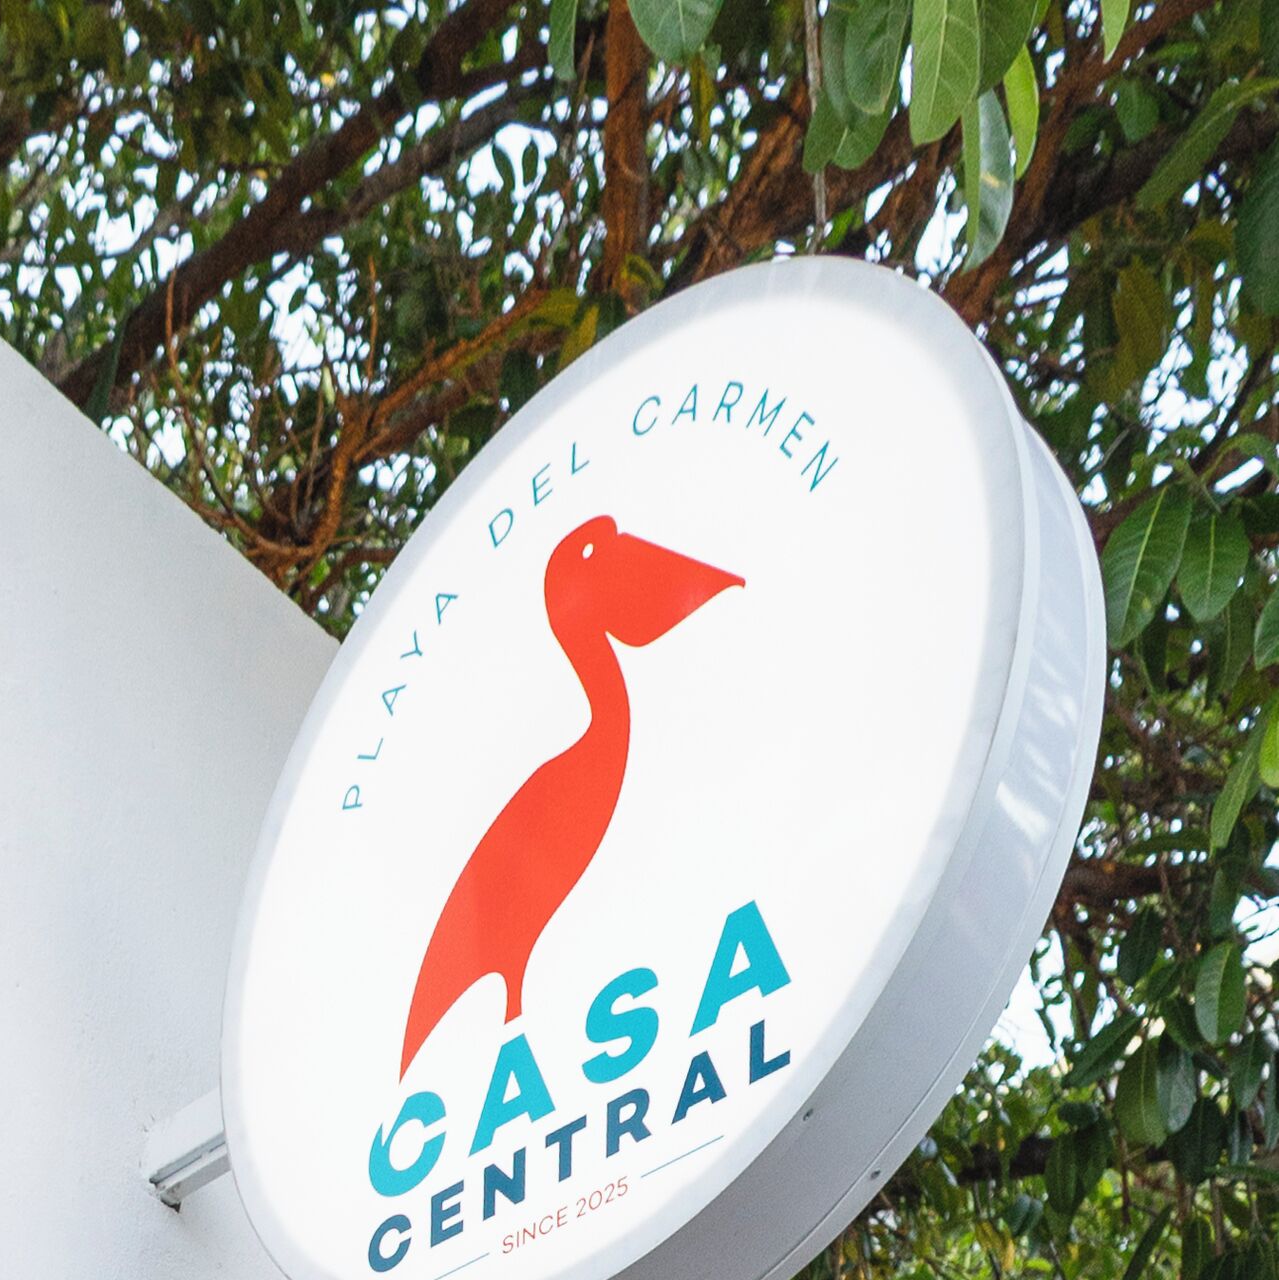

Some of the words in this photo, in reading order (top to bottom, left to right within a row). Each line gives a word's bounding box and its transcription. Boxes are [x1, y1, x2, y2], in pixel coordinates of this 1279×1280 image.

[341, 592, 459, 811] PLAYA
[487, 441, 590, 549] DEL
[632, 380, 839, 493] CARMEN
[367, 899, 793, 1198] CASA
[367, 1018, 791, 1273] CENTRAL
[502, 1207, 568, 1254] SINCE
[576, 1177, 628, 1218] 2025
